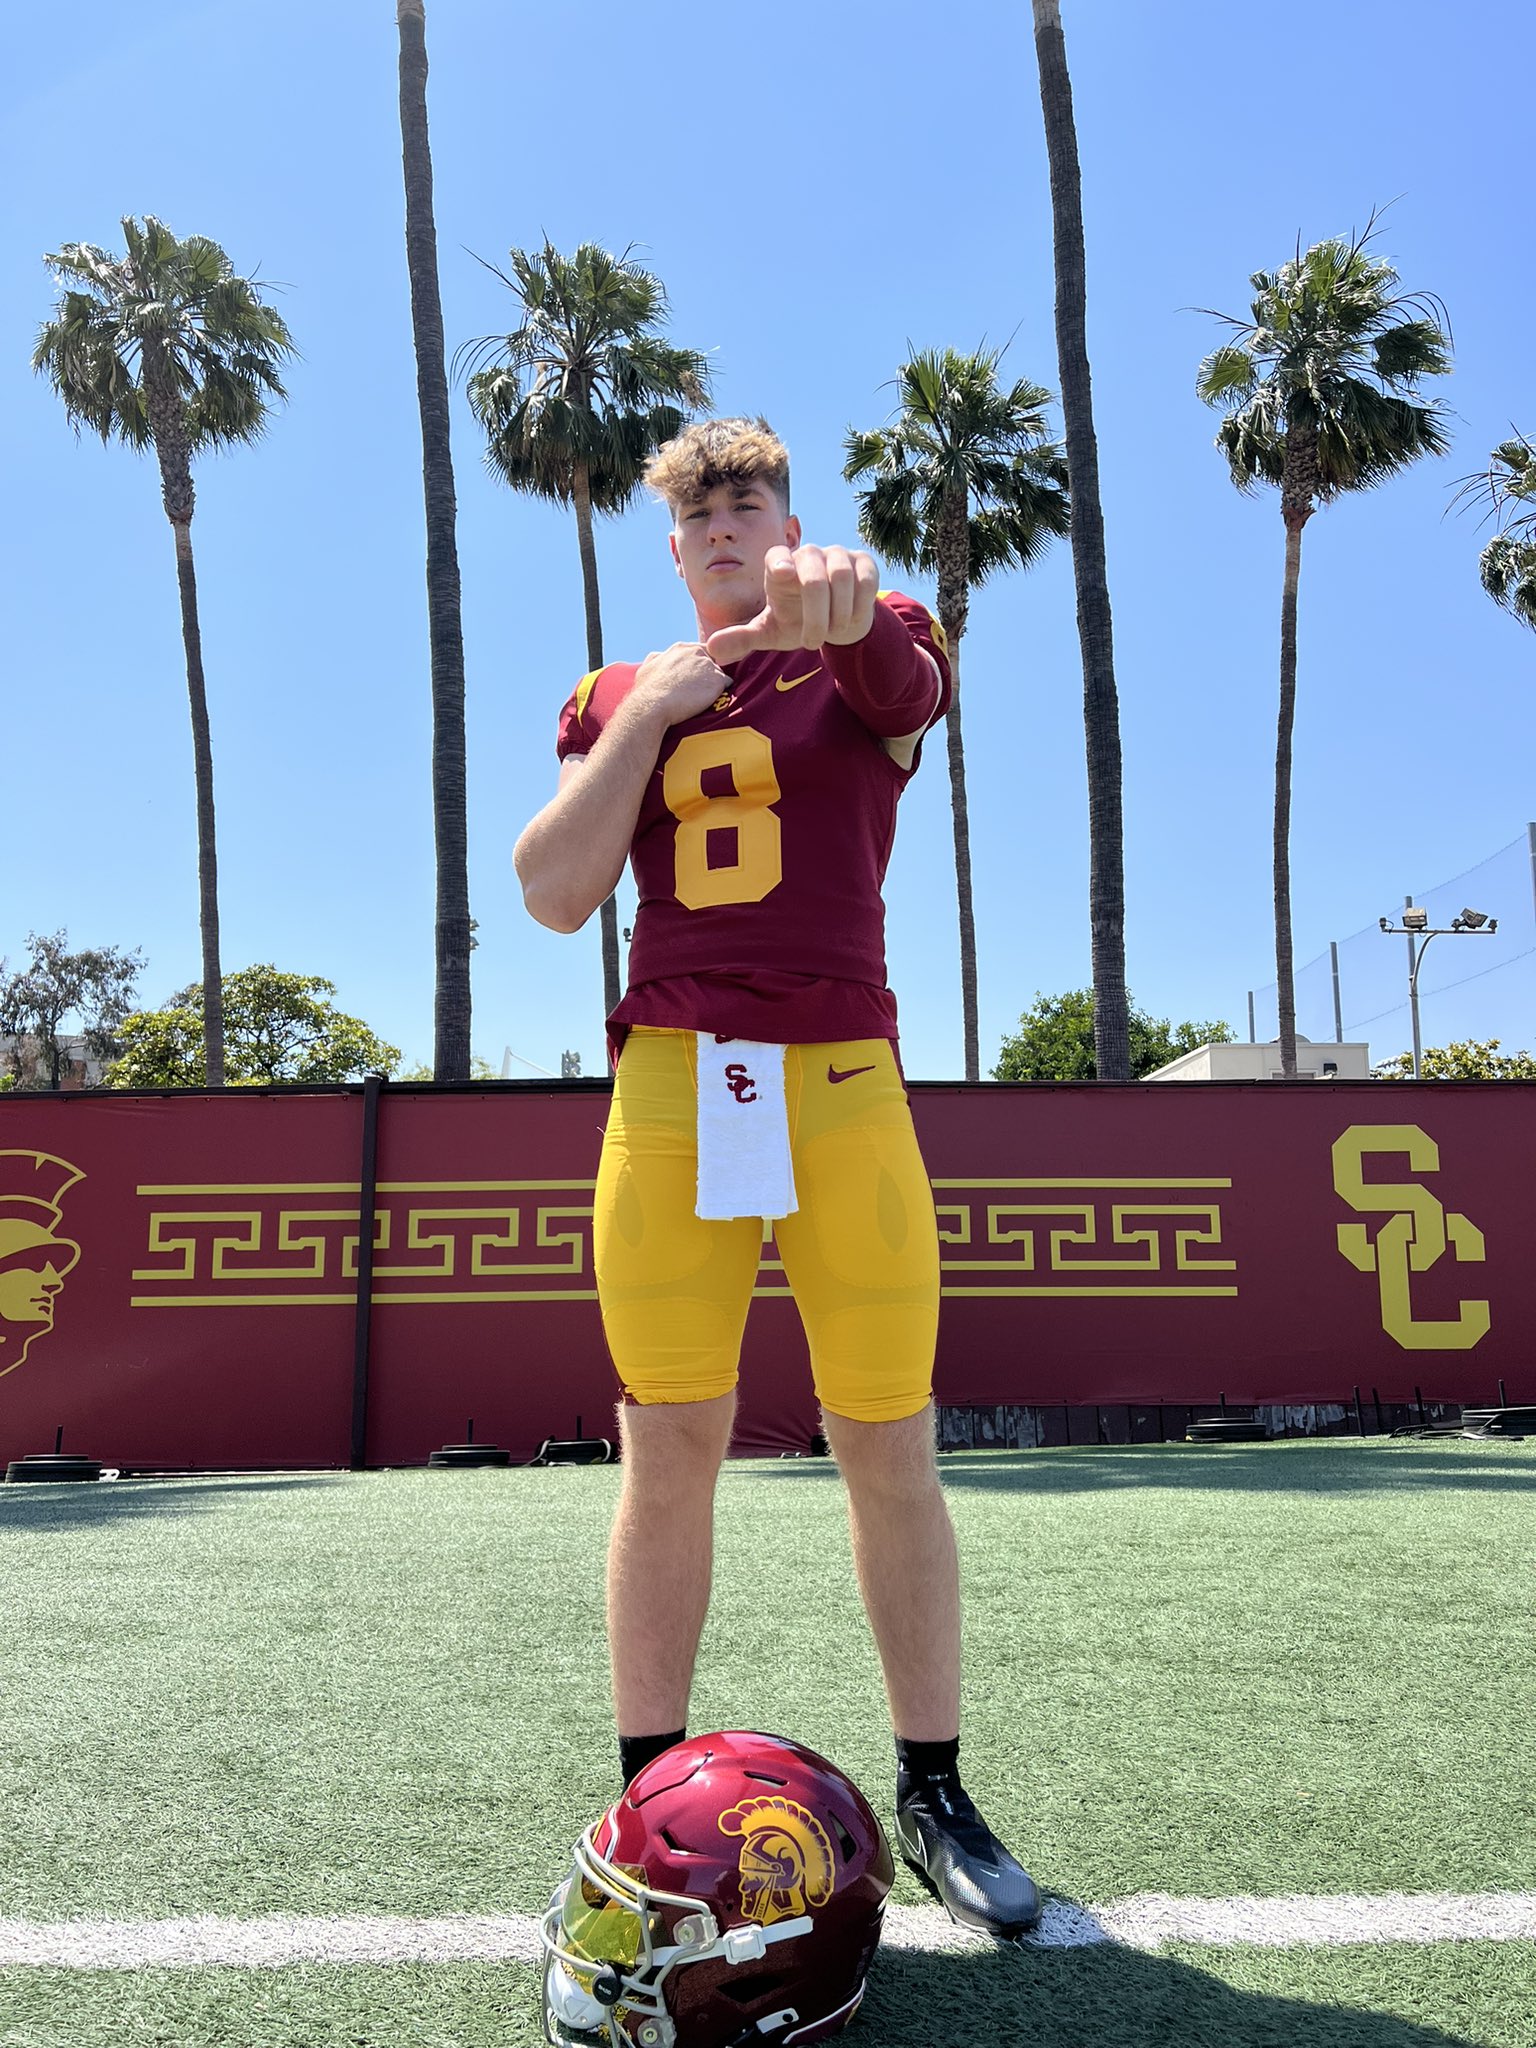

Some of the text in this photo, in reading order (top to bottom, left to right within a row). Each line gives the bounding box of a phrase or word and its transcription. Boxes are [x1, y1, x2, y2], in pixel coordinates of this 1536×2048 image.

[663, 726, 783, 911] 8
[725, 1064, 757, 1103] SC
[1331, 1124, 1491, 1350] SC
